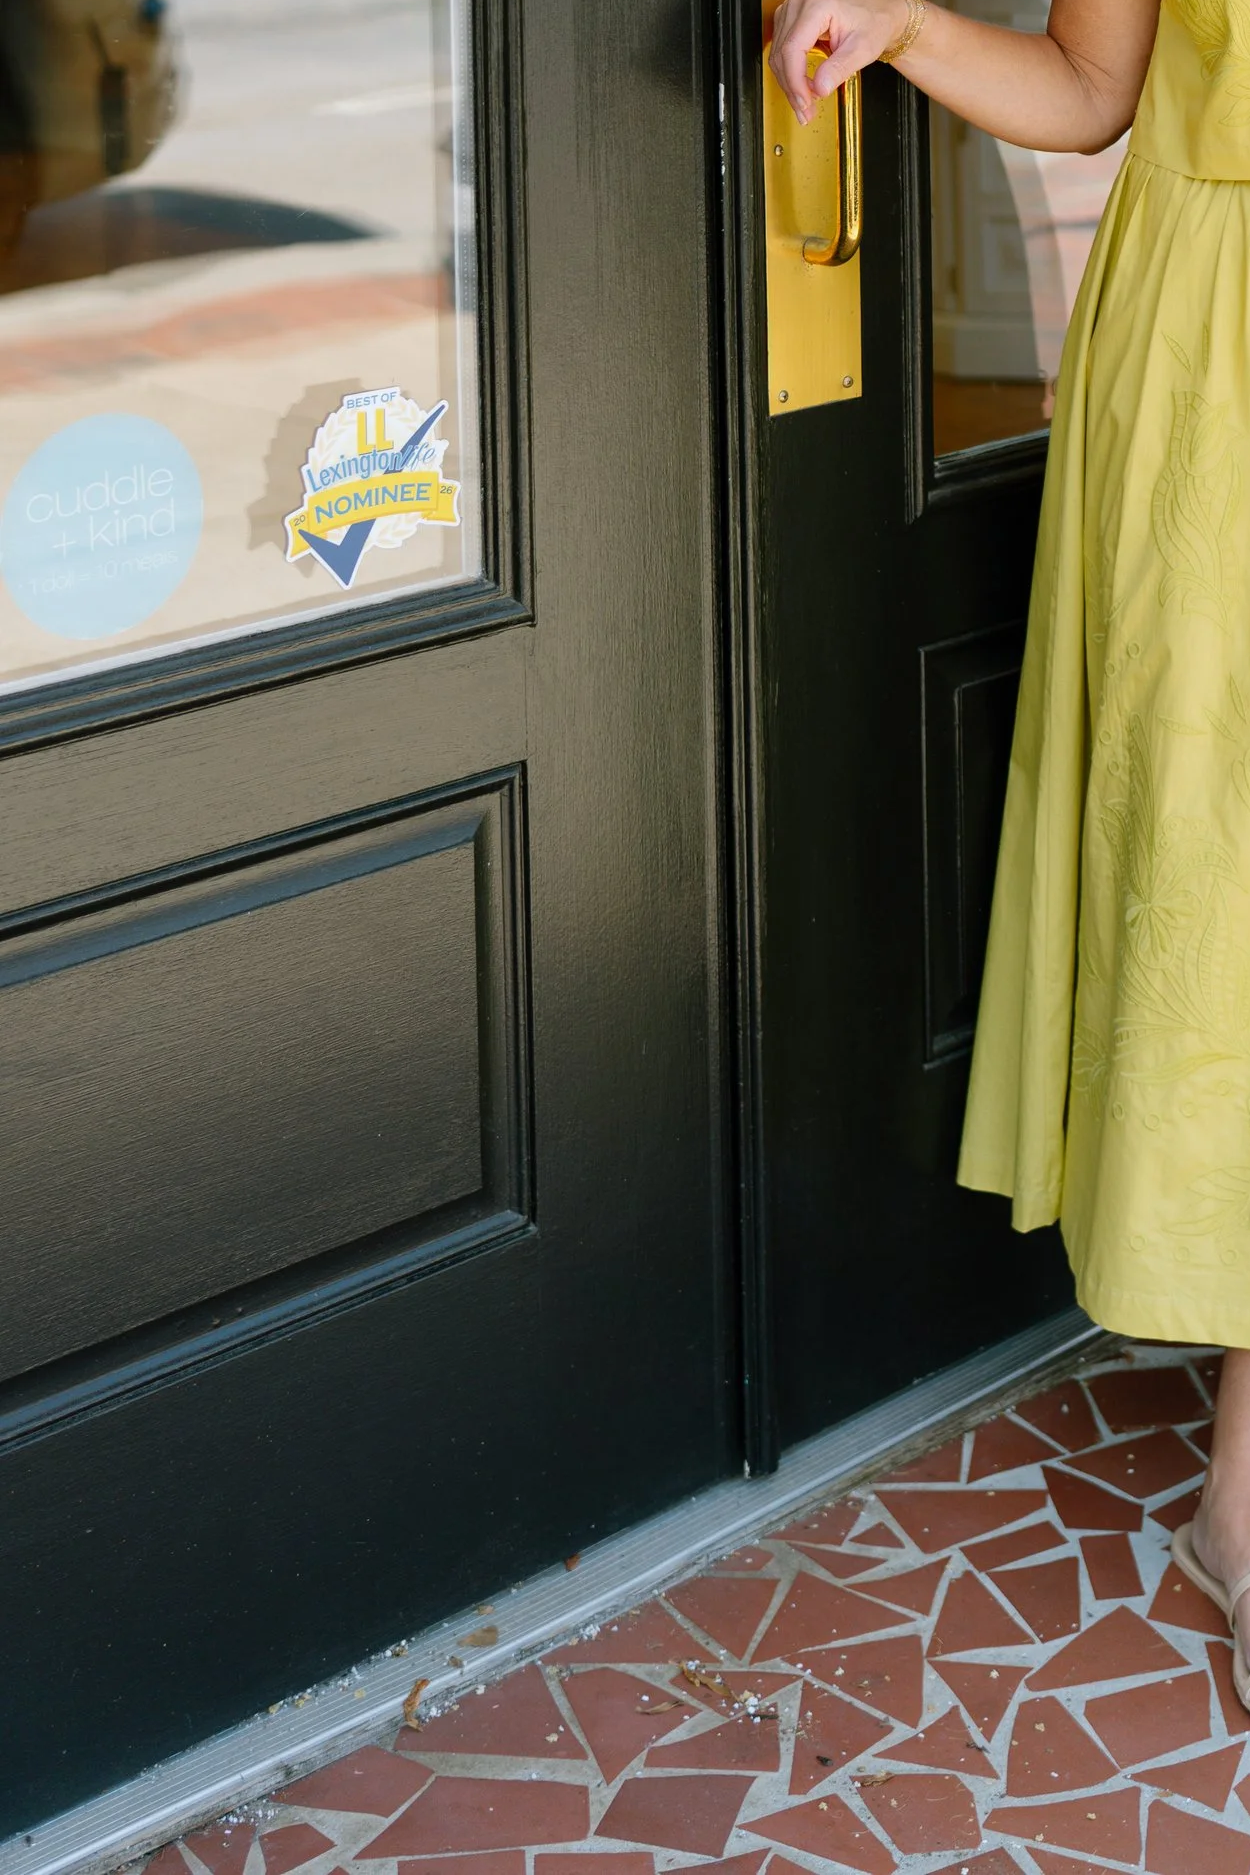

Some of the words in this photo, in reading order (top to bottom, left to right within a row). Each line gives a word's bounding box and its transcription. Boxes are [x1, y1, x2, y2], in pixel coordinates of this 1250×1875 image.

[346, 395, 379, 409] BEST
[380, 391, 398, 403] OF
[357, 408, 394, 455] LL
[26, 463, 174, 523] cuddle
[314, 482, 432, 524] NOMINEE
[440, 485, 453, 495] 26
[51, 531, 77, 560] +
[90, 497, 175, 552] kind
[293, 514, 306, 526] 20
